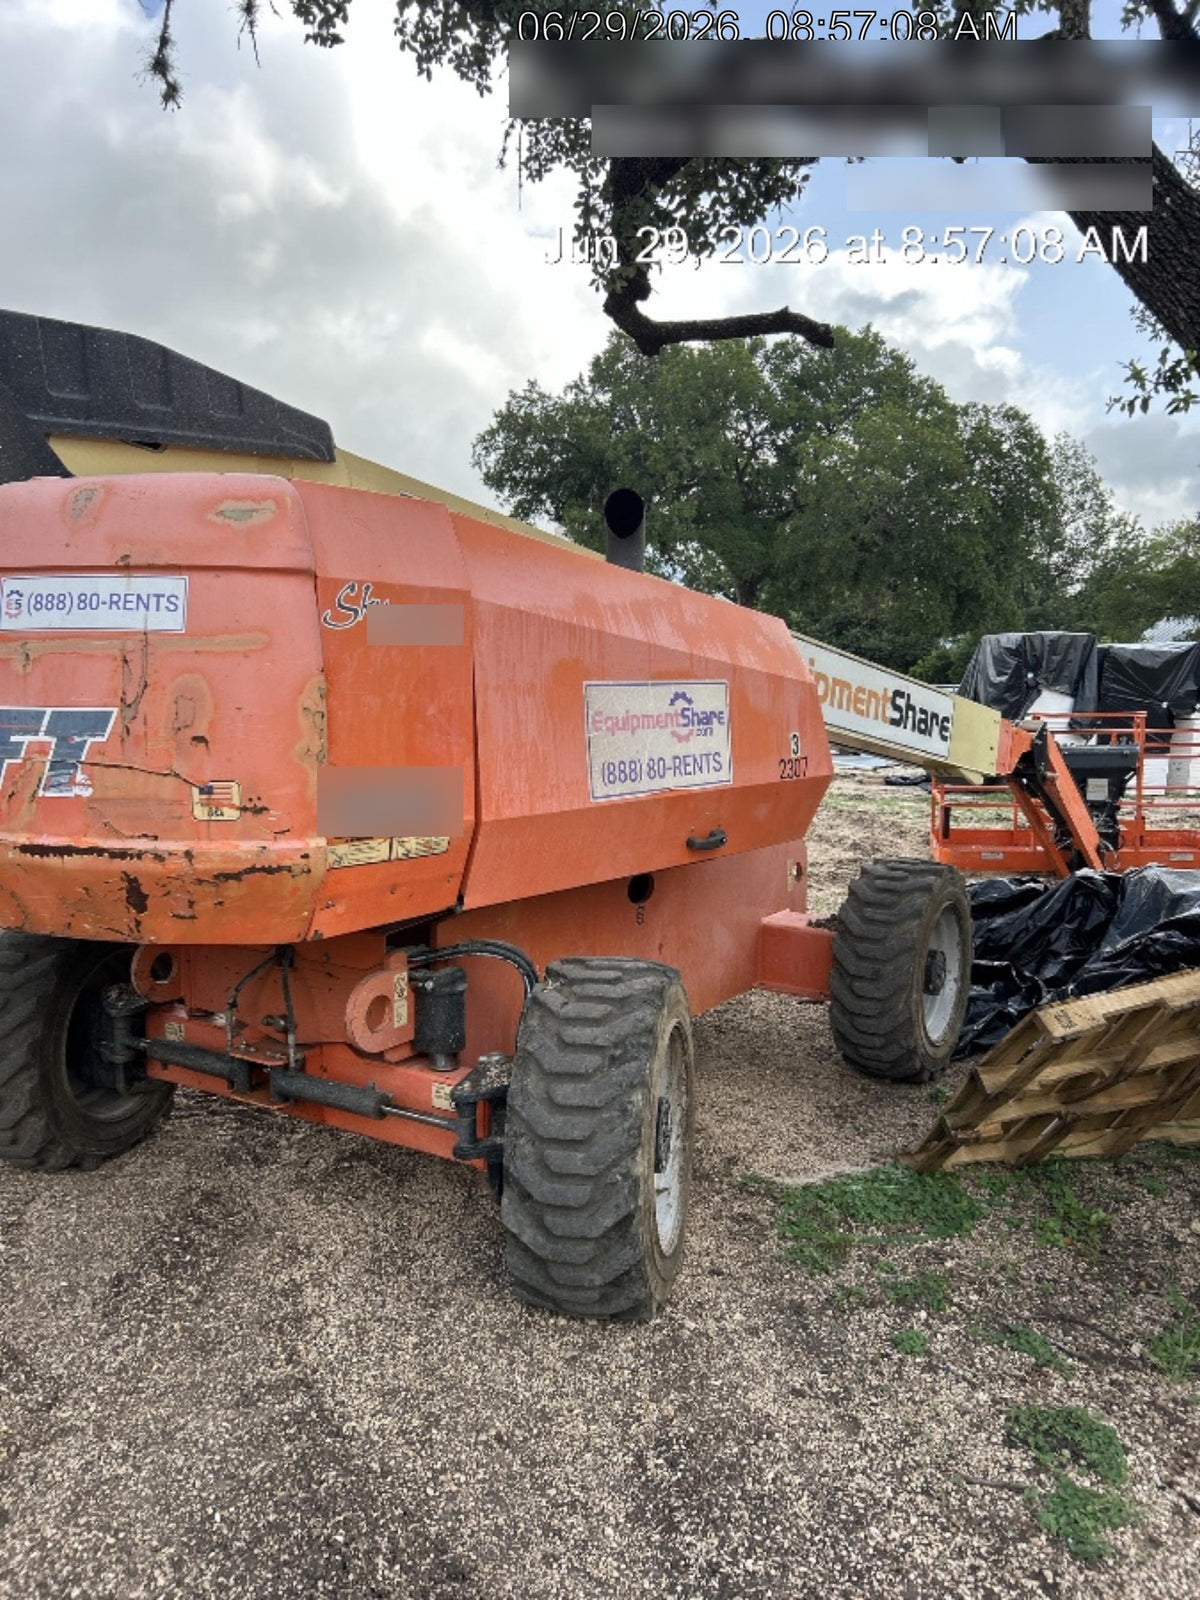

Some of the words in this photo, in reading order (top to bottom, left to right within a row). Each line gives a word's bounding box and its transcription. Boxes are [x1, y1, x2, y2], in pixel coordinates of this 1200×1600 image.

[27, 592, 73, 616] (888)
[77, 593, 179, 612] 80-RENTS
[322, 581, 391, 629] Sk
[592, 707, 725, 737] EquipmentShare
[791, 733, 799, 756] 3
[602, 760, 643, 787] (888)
[646, 751, 723, 780] 80-RENTS
[779, 756, 808, 779] 2307
